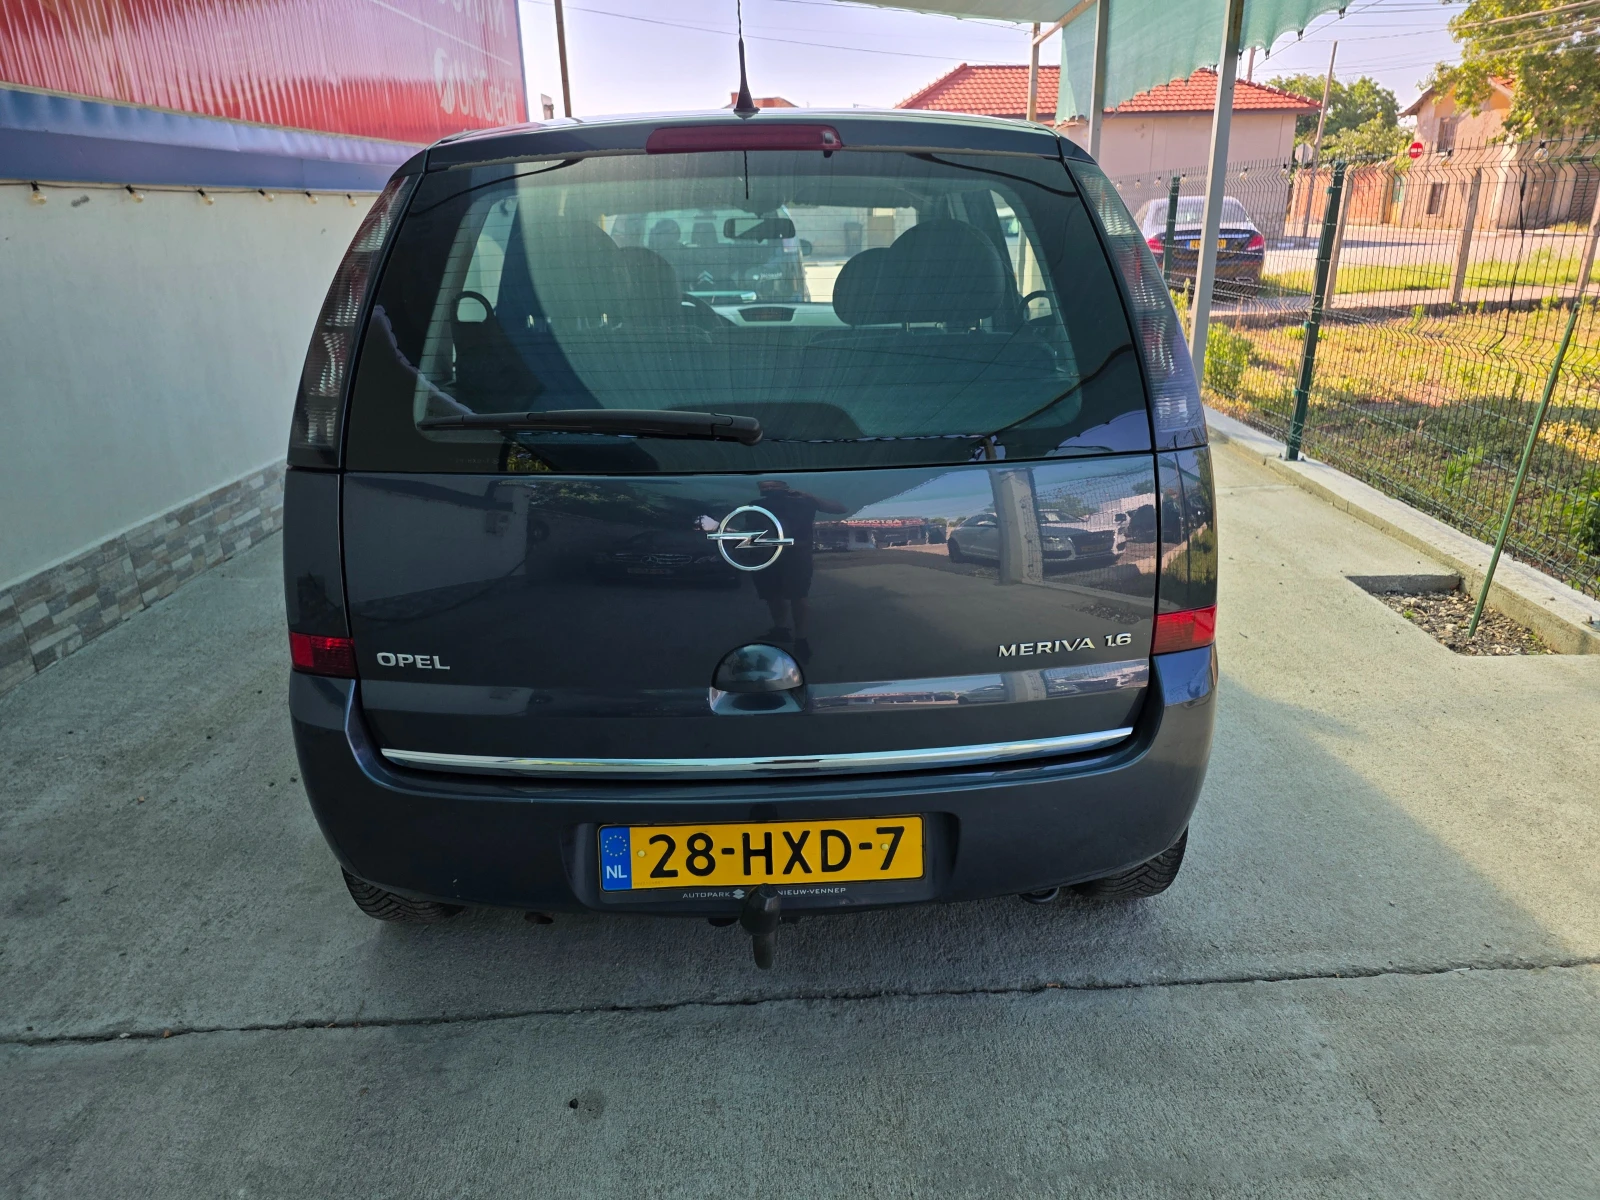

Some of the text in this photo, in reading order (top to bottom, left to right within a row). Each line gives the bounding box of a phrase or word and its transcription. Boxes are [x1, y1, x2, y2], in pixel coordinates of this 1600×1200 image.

[998, 637, 1095, 657] MERIVA
[377, 652, 450, 670] OPEL
[649, 825, 905, 878] 28-HXD-7
[606, 864, 628, 879] NL
[682, 890, 731, 898] AUTOPARK
